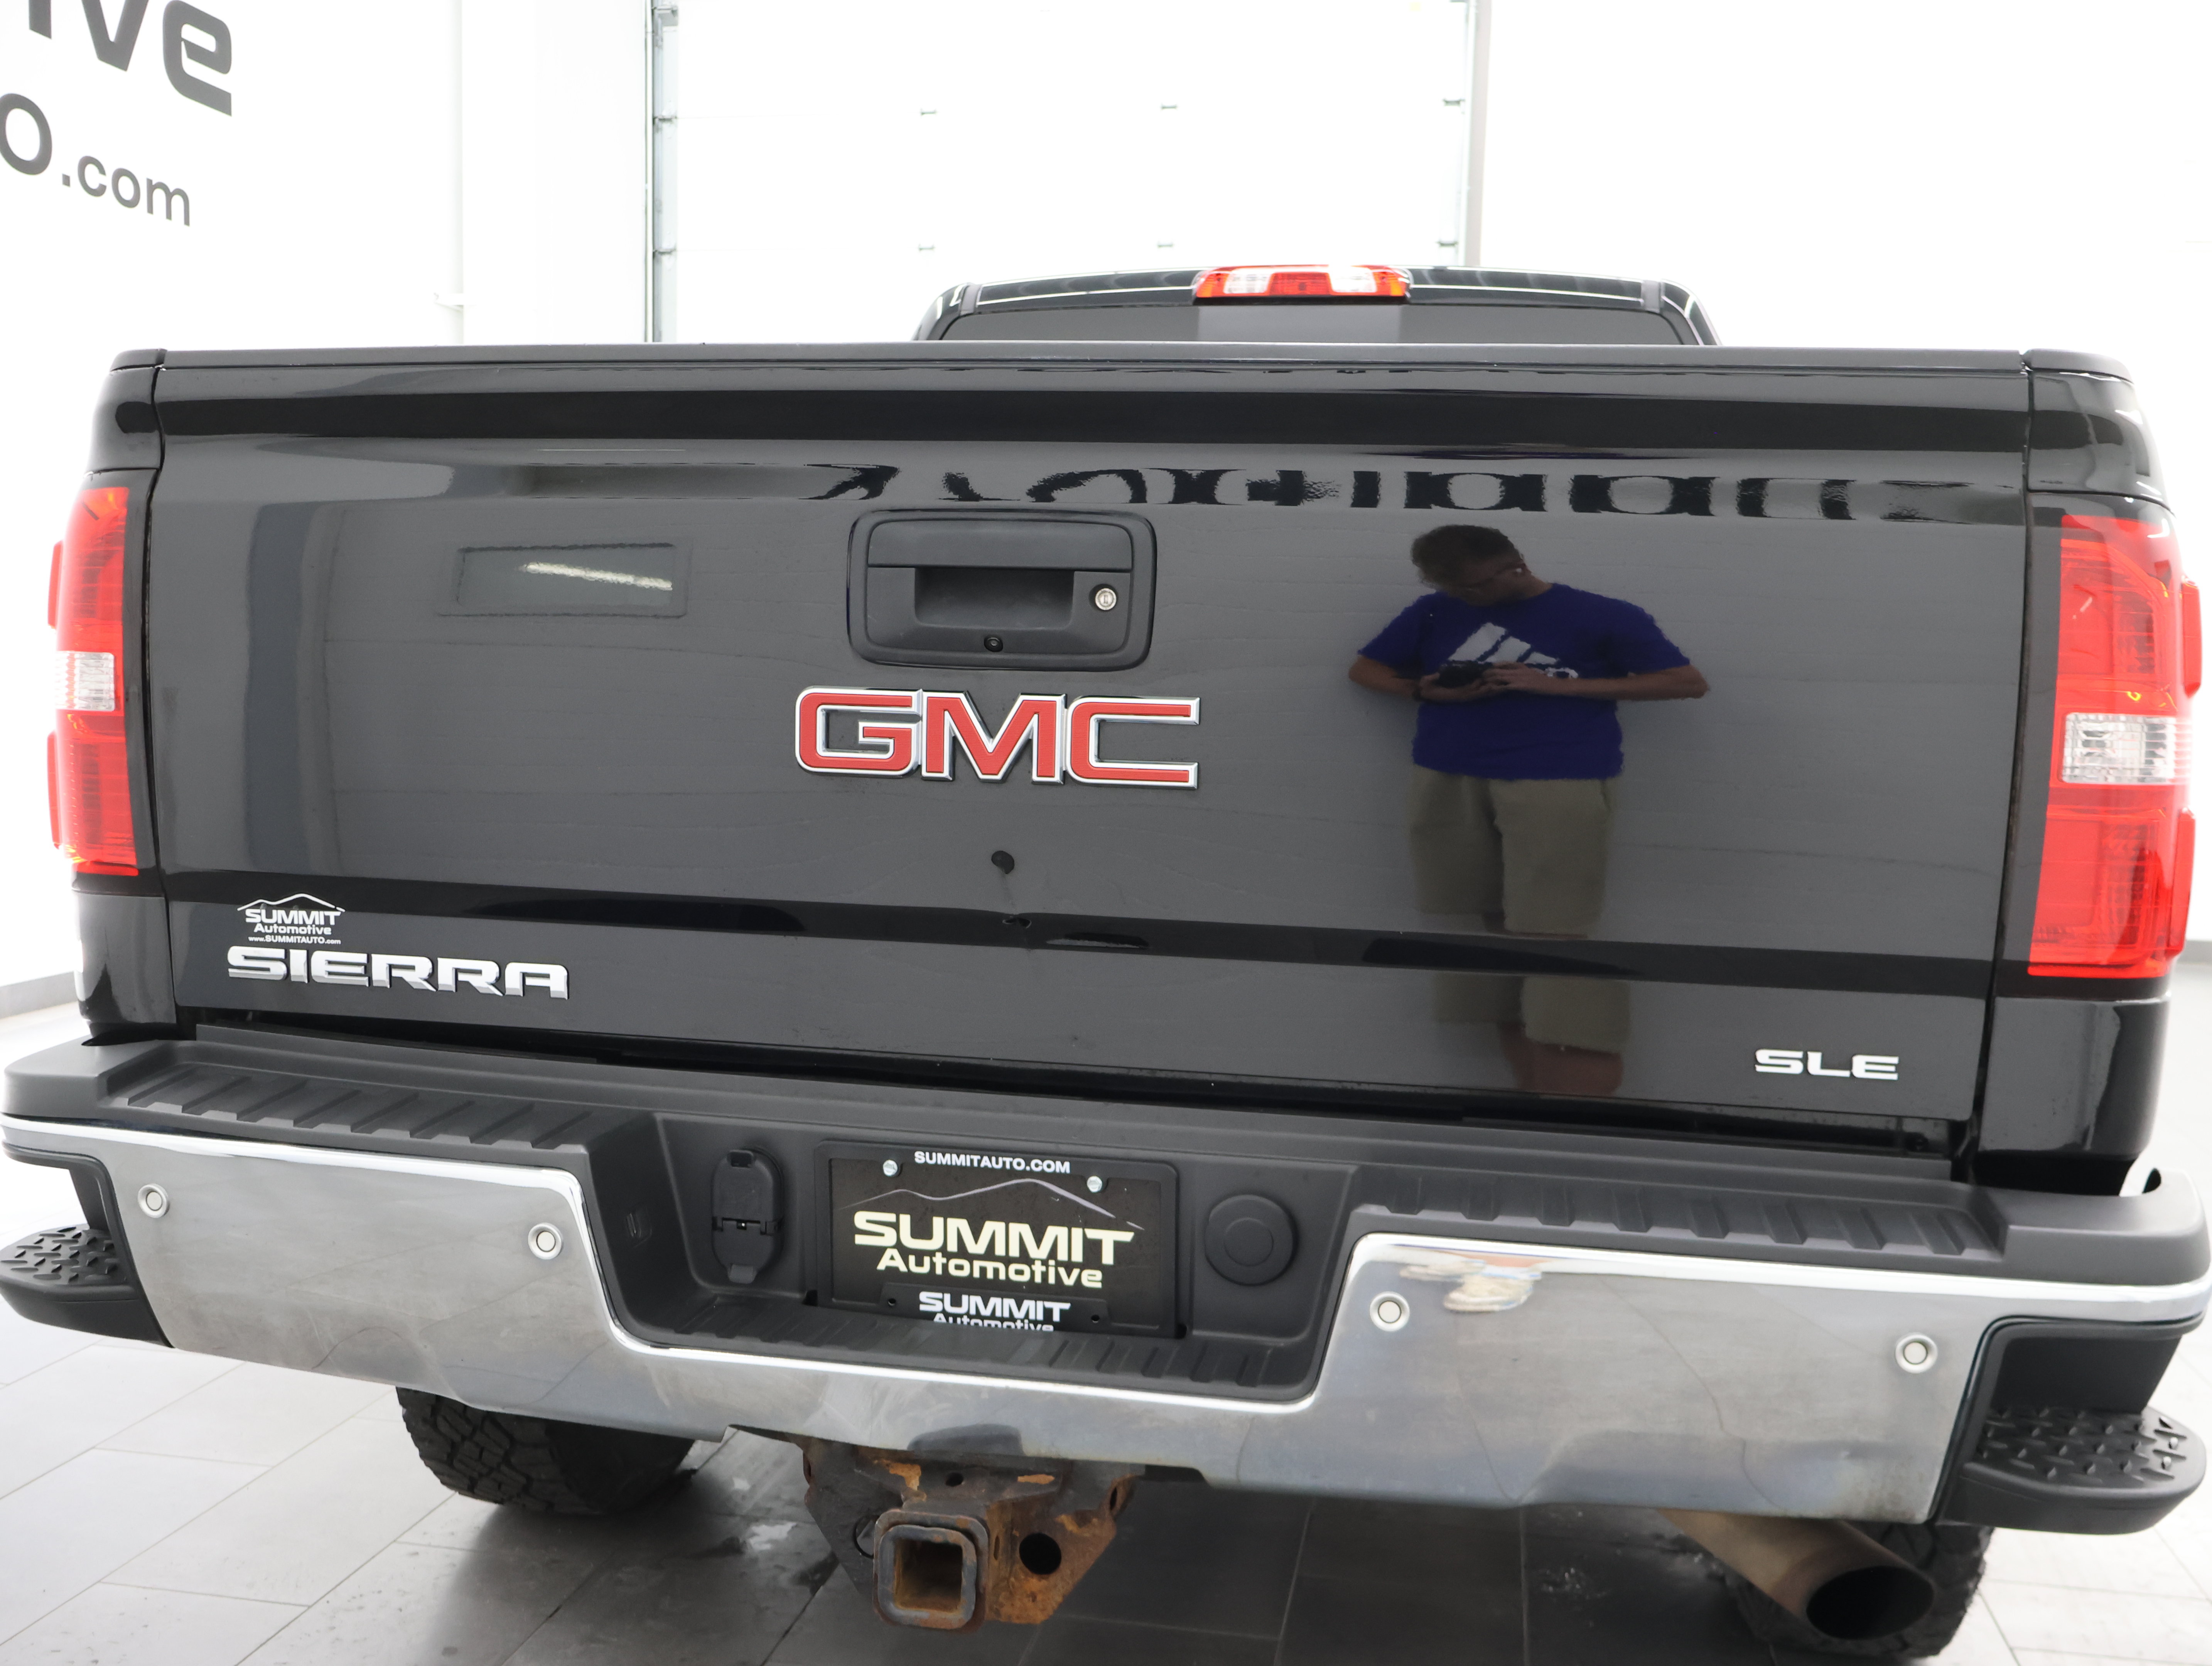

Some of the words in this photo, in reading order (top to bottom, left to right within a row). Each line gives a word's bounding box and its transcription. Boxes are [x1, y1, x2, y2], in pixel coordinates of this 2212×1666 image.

[795, 686, 1200, 789] GMC
[245, 909, 341, 926] SUMMIT
[253, 923, 332, 935] Automotive
[248, 934, 341, 944] www.SUMMITAUTO.com
[228, 946, 569, 1000] SIERRA
[1755, 1049, 1899, 1080] SLE
[914, 1151, 1070, 1174] SUMMITAUTO.COM
[854, 1211, 1134, 1265] SUMMIT
[877, 1248, 1103, 1288] Automotive
[919, 1291, 1071, 1322] SUMMIT
